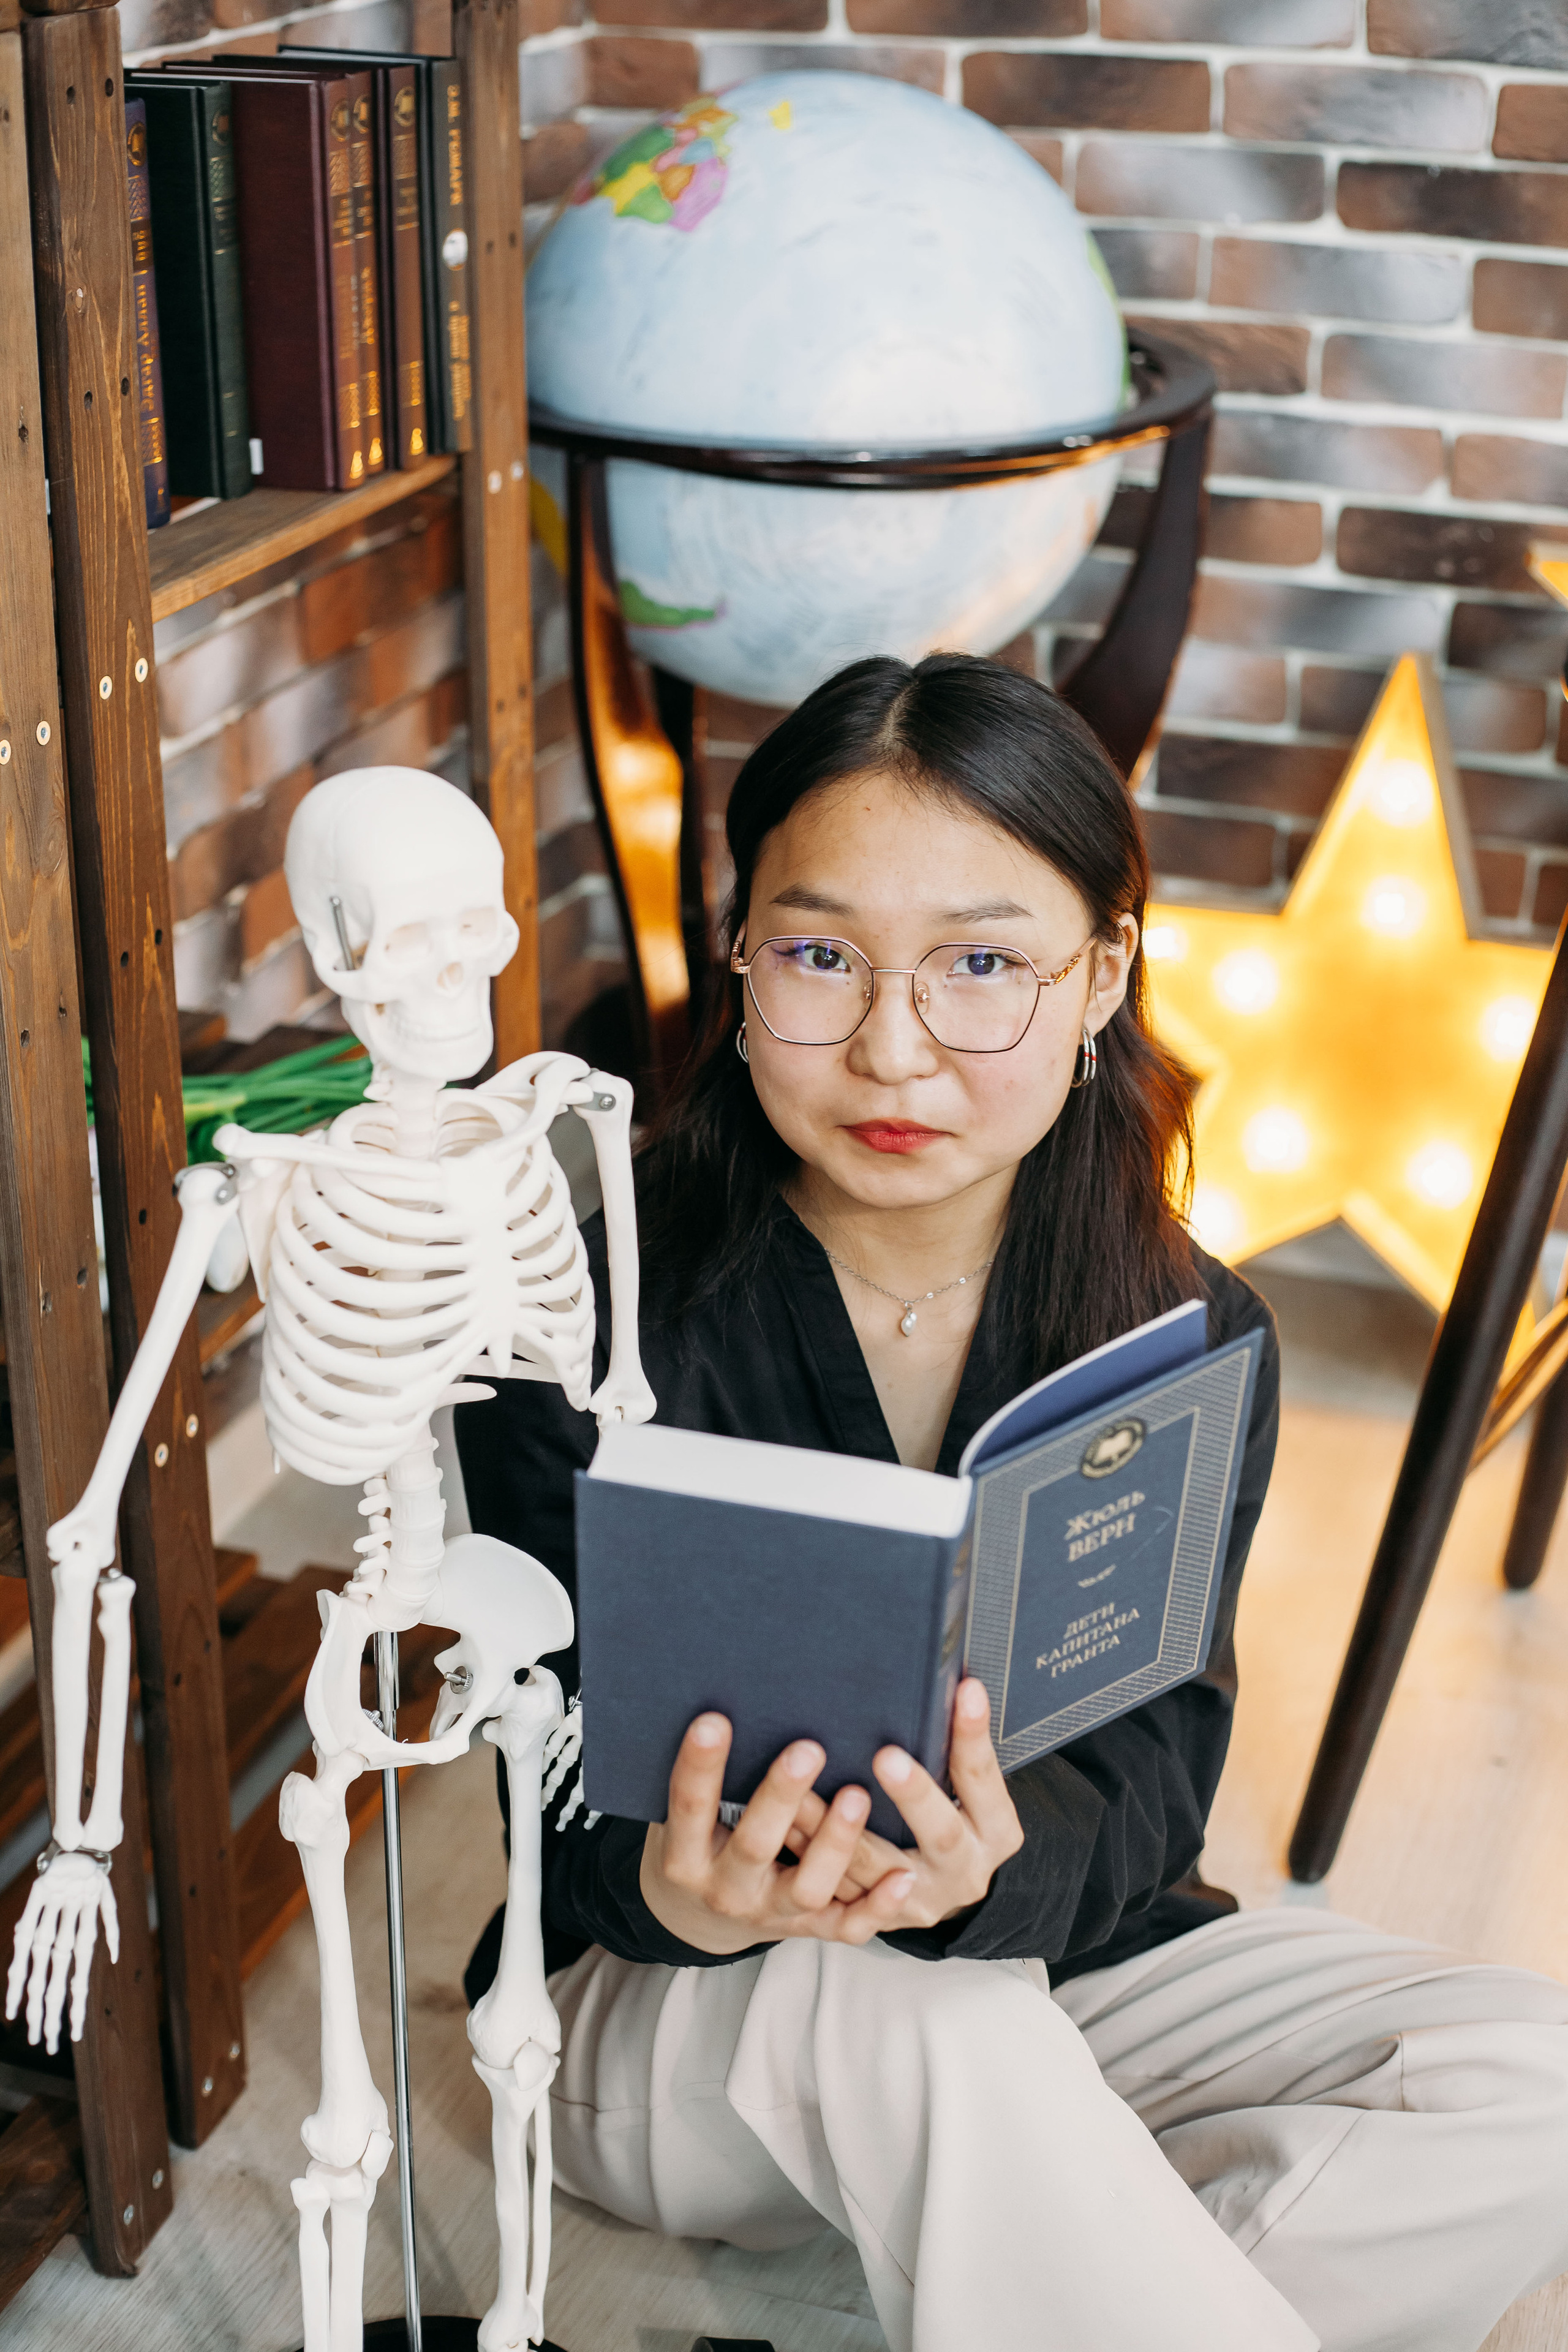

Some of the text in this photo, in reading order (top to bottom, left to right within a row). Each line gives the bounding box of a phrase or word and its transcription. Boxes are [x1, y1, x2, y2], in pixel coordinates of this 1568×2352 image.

[1064, 1491, 1145, 1540] ЖЮЛЬ
[1068, 1512, 1136, 1562] ВЕРН
[1036, 1608, 1140, 1669] КАПИТАНА
[1063, 1602, 1115, 1640] ДЕТИ
[1051, 1635, 1120, 1678] ГРАНТА
